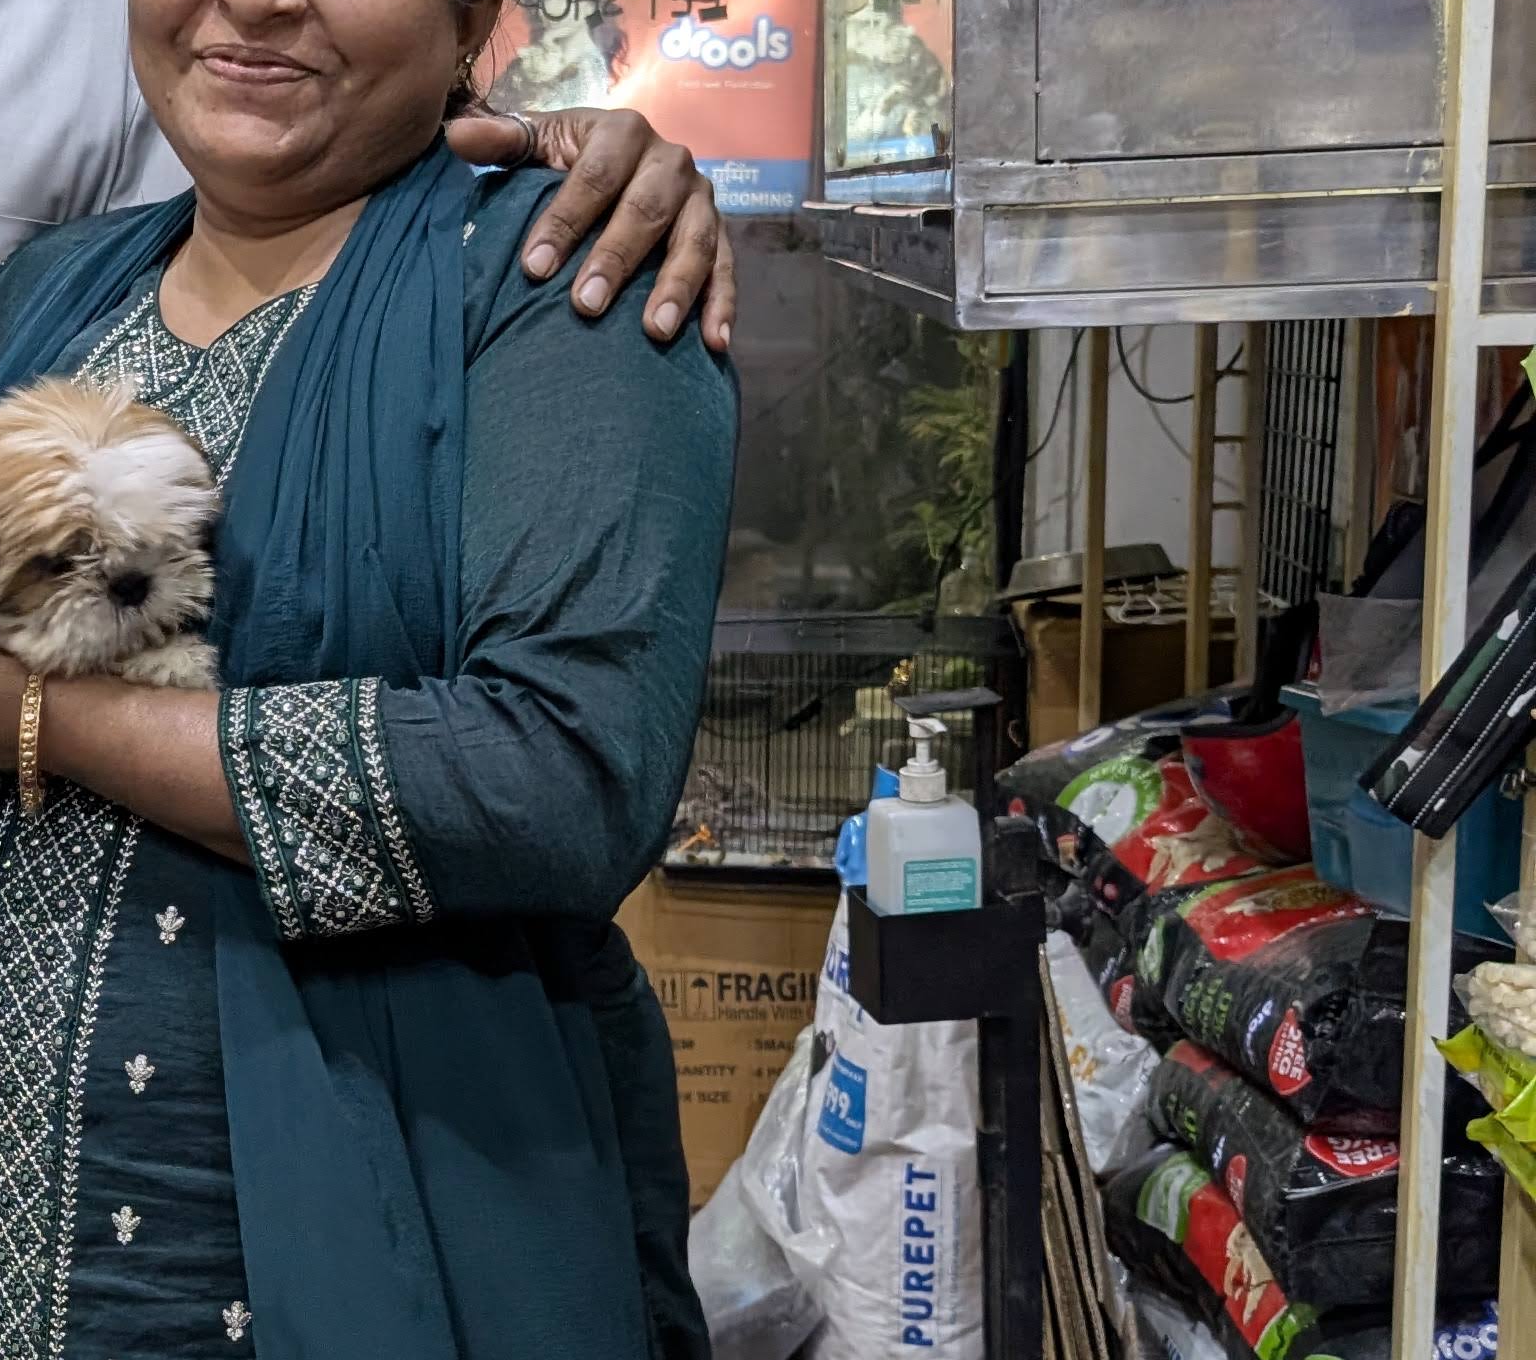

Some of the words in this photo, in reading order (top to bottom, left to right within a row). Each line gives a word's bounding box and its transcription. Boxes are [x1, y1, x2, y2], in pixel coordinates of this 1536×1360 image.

[660, 16, 792, 70] drools
[714, 191, 795, 209] ROOMING
[718, 1005, 769, 1022] Handle
[901, 1162, 939, 1349] PUREPET
